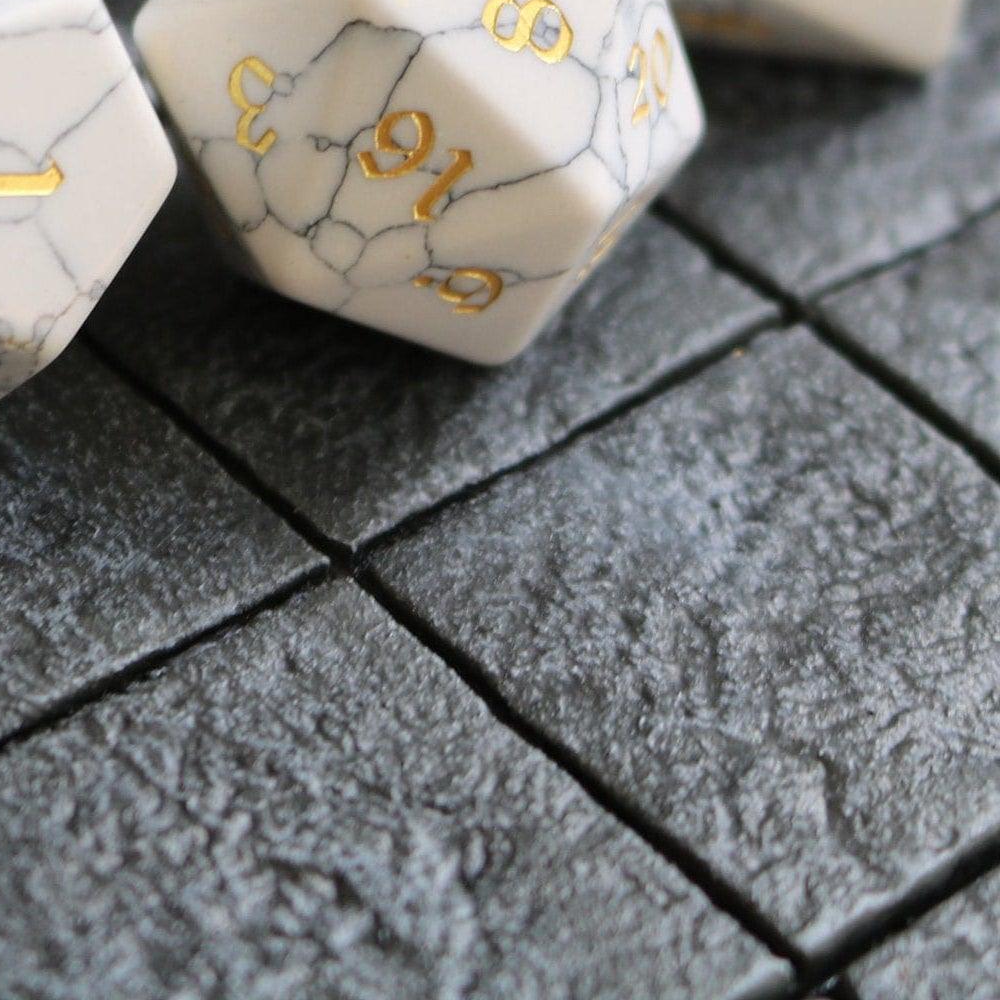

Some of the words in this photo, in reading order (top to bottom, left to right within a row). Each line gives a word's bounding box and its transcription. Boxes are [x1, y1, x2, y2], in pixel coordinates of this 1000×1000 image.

[228, 56, 277, 155] 3
[628, 29, 673, 125] 20
[357, 110, 474, 222] 16
